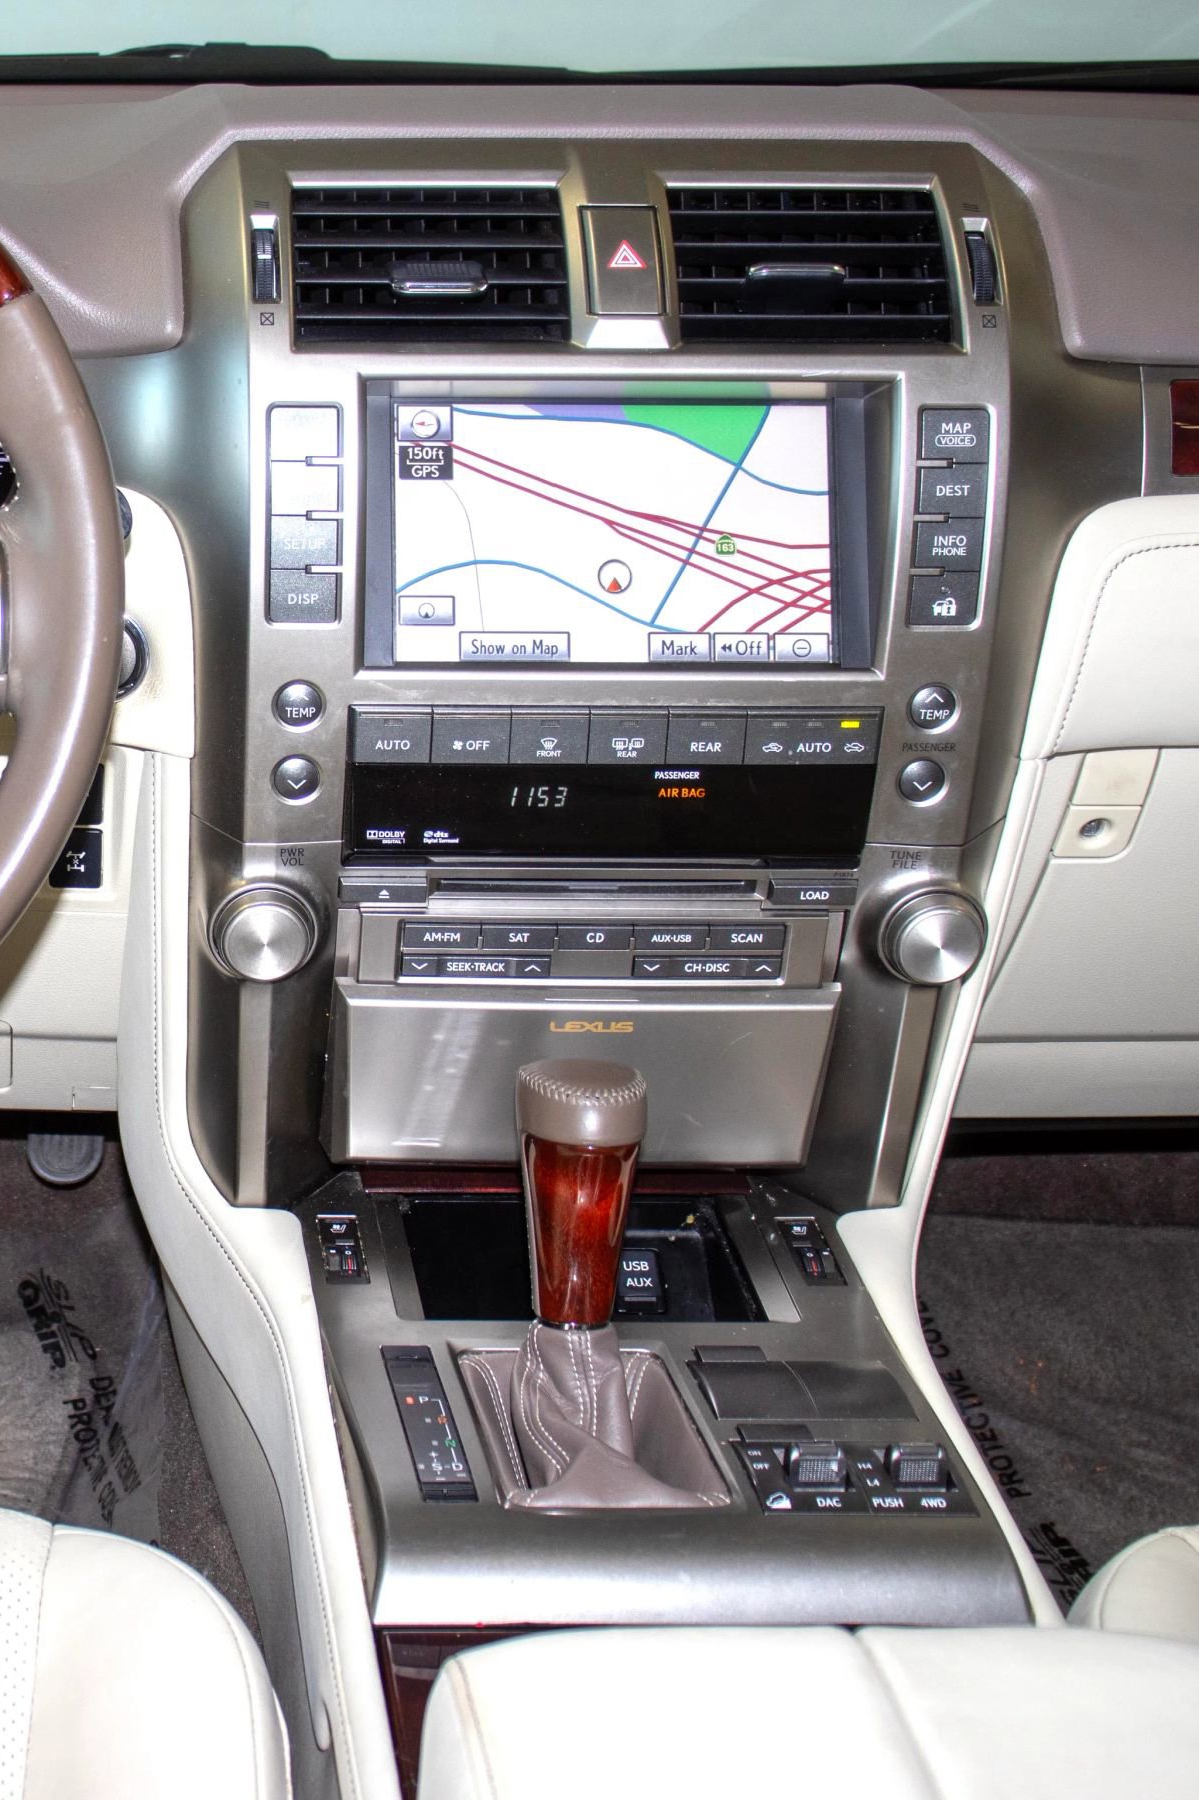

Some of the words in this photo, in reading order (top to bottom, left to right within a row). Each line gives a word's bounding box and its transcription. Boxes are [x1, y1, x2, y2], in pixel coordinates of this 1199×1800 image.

[941, 423, 971, 434] MAP
[939, 436, 971, 445] VOICE
[407, 447, 444, 460] 150ft
[411, 466, 439, 478] GPS
[936, 485, 970, 496] DEST
[716, 542, 734, 552] 163
[933, 536, 967, 547] INFO
[932, 547, 966, 556] PHONE
[288, 594, 319, 605] DISP
[471, 640, 506, 656] Show
[512, 645, 527, 655] on
[532, 640, 558, 659] Map
[661, 641, 697, 656] Mark
[736, 641, 762, 656] Off
[286, 707, 316, 718] TEMP
[919, 709, 950, 721] TEMP
[375, 740, 410, 750] AUTO
[466, 740, 490, 750] OFF
[690, 741, 721, 753] REAR
[796, 742, 831, 753] AUTO
[902, 742, 956, 752] PASSENGER
[654, 771, 700, 780] PASSENGER
[511, 787, 568, 807] 1153
[658, 787, 679, 798] AIR
[682, 787, 705, 798] BAG
[280, 849, 304, 857] PWR
[890, 850, 921, 860] TUNE
[282, 858, 304, 866] VOL
[892, 860, 917, 870] FILE
[800, 891, 829, 900] LOAD
[509, 932, 530, 943] SAT
[586, 933, 604, 943] CD
[731, 933, 762, 943] SCAN
[549, 1021, 634, 1033] LEXUS
[622, 1260, 650, 1271] USB
[626, 1277, 653, 1287] AUX
[914, 1294, 950, 1360] COVE
[418, 1396, 429, 1404] P
[944, 1368, 1033, 1500] PROTECTIVE
[445, 1438, 457, 1448] N
[432, 1463, 443, 1472] S
[452, 1463, 463, 1472] D
[866, 1479, 880, 1487] L4
[816, 1497, 841, 1508] DAC
[872, 1497, 904, 1508] PUSH
[920, 1497, 947, 1508] 4WD
